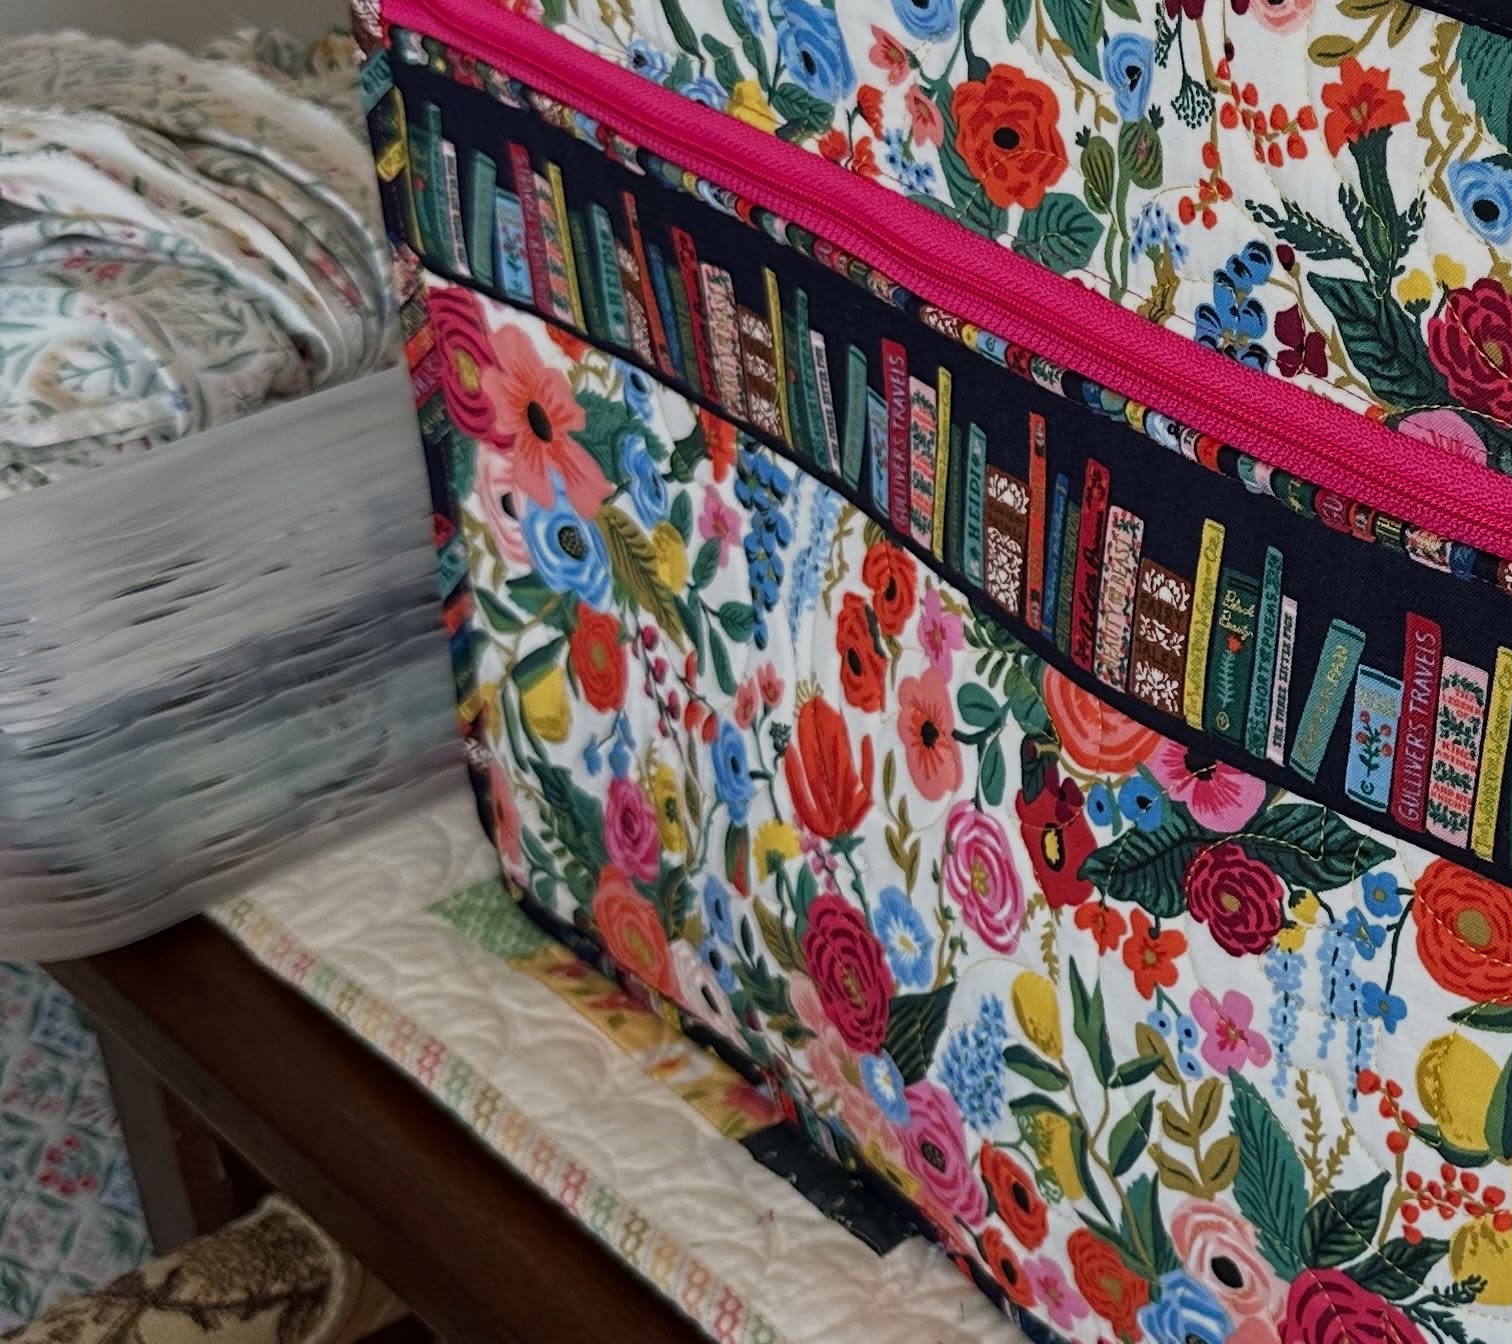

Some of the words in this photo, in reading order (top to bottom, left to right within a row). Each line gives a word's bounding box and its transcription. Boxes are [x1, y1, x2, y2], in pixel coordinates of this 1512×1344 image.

[890, 354, 906, 430] TRAVELS
[967, 467, 985, 537] HEIDI
[1260, 590, 1278, 648] POEMS
[1254, 666, 1270, 719] SHORT
[1411, 631, 1437, 714] TRAVELS
